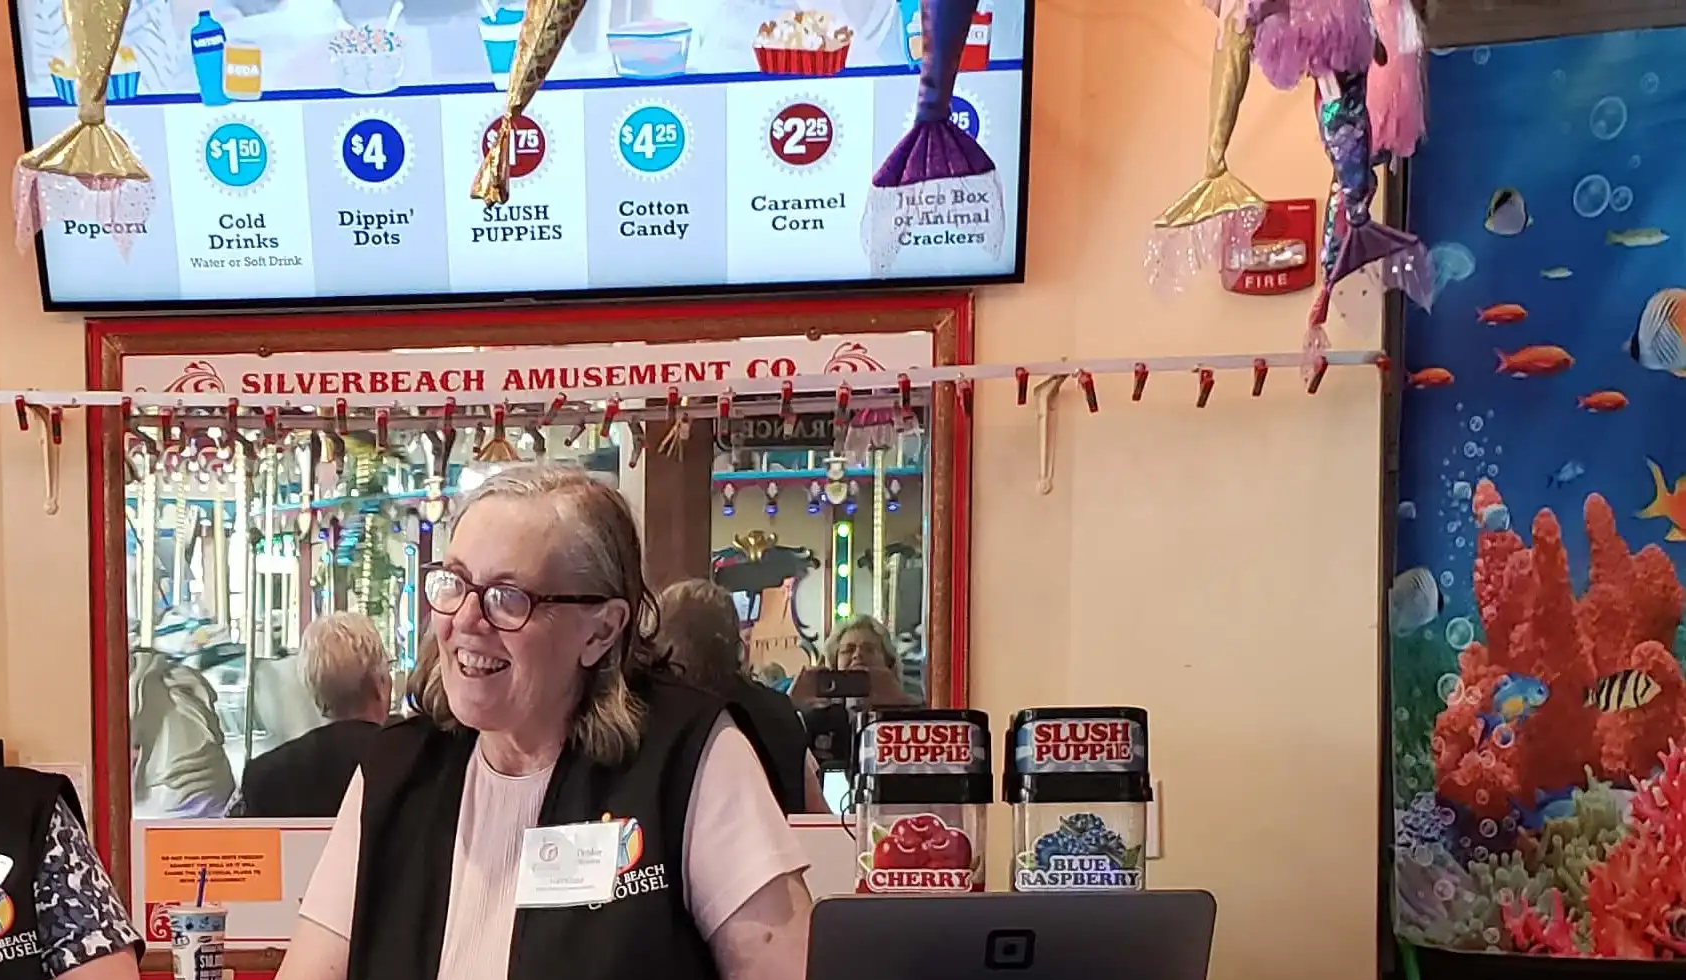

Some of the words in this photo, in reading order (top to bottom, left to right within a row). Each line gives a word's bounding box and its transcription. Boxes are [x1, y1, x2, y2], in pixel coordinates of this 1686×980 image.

[351, 133, 387, 170] $4
[751, 194, 846, 212] Caramel
[951, 188, 989, 204] Box
[482, 205, 550, 223] SLUSH
[618, 200, 690, 217] Cotton
[63, 218, 148, 238] Popcorn
[218, 213, 267, 230] Cold
[338, 209, 415, 229] Dippin'
[771, 214, 825, 231] Corn
[893, 214, 914, 229] or
[353, 229, 401, 247] Dots
[619, 220, 689, 239] Candy
[898, 229, 985, 246] Crackers
[208, 233, 280, 251] Drinks
[190, 257, 226, 268] Water
[228, 258, 242, 268] or
[244, 256, 271, 267] Soft
[273, 255, 302, 266] Drink
[1244, 273, 1289, 289] FIRE
[241, 369, 485, 396] SILVERBEACH
[502, 359, 731, 391] AMUSEMENT
[876, 724, 971, 745] SLUSH
[1034, 722, 1131, 744] SLUSH
[624, 863, 665, 883] BEACH
[1052, 857, 1107, 871] BLUE
[614, 874, 669, 900] OUSEL
[871, 871, 972, 889] CHERRY
[1020, 870, 1141, 888] RASPBERRY
